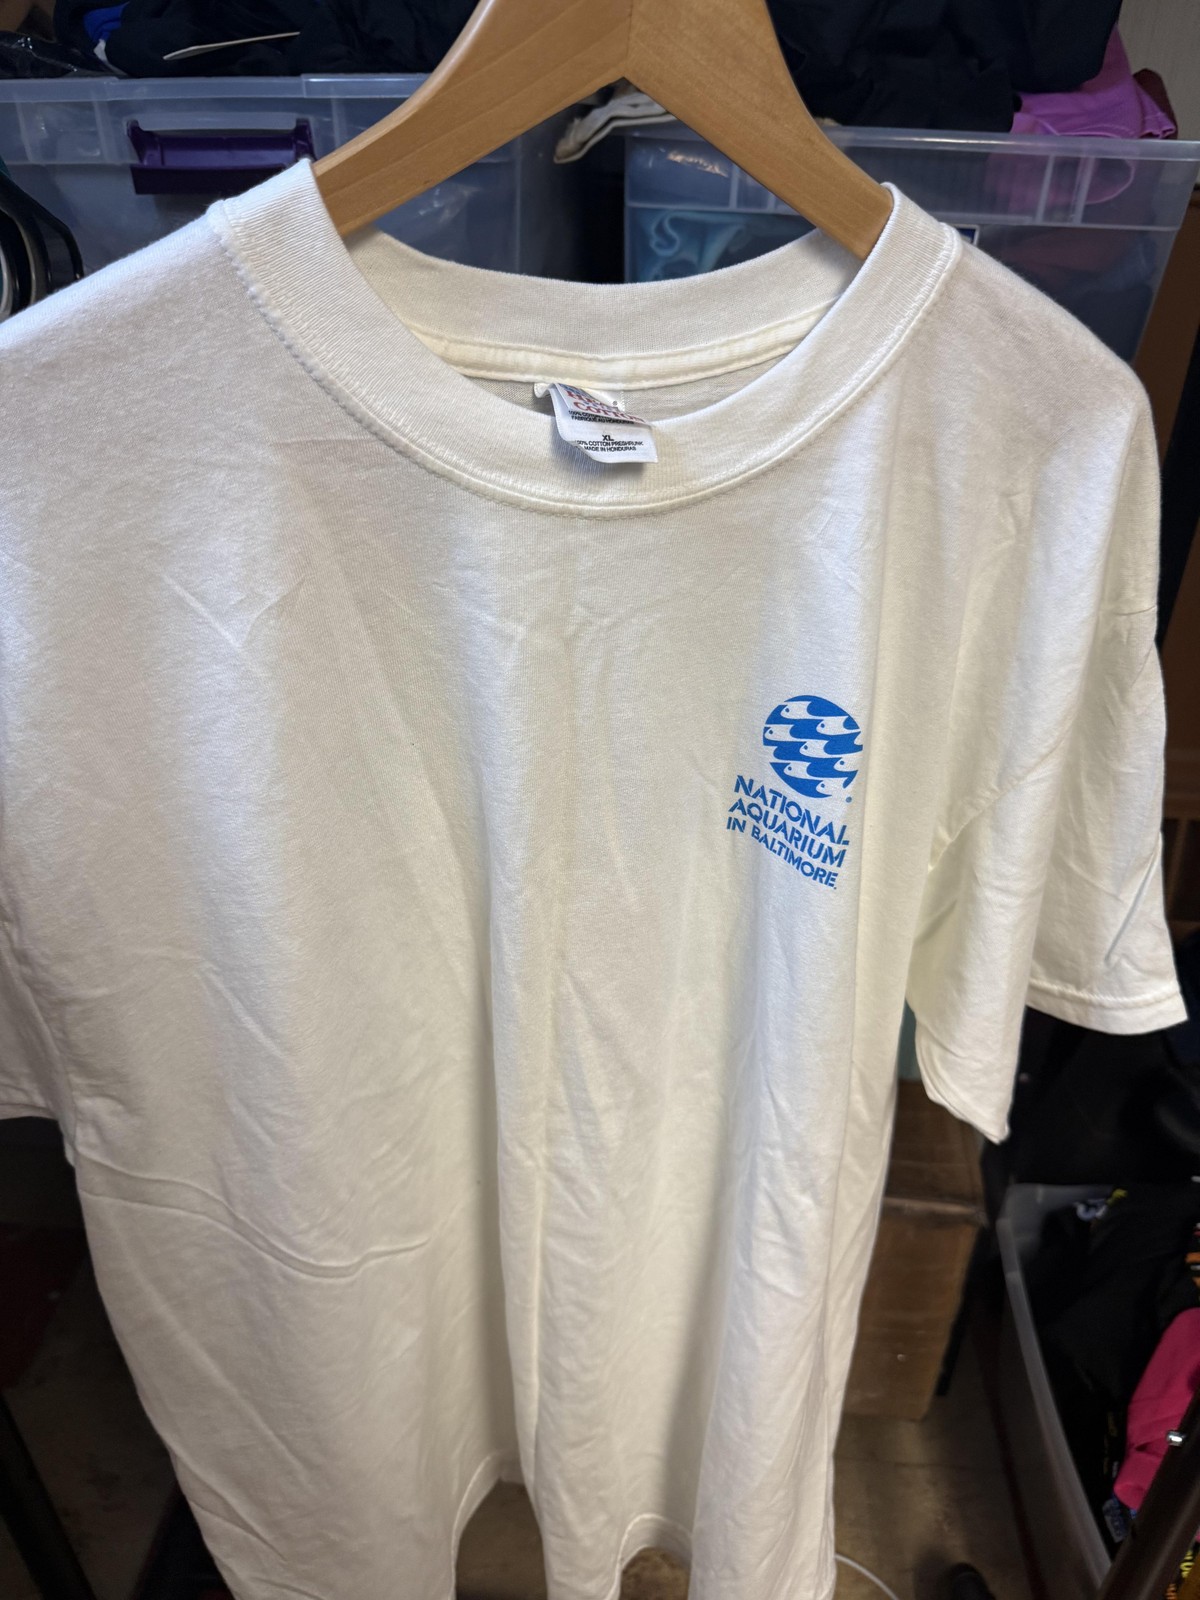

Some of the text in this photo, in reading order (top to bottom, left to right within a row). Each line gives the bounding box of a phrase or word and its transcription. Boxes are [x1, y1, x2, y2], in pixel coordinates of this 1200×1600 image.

[602, 434, 614, 442] XL
[726, 816, 747, 833] IN
[734, 775, 849, 846] NATIONAL
[728, 798, 847, 868] AQUARIUM
